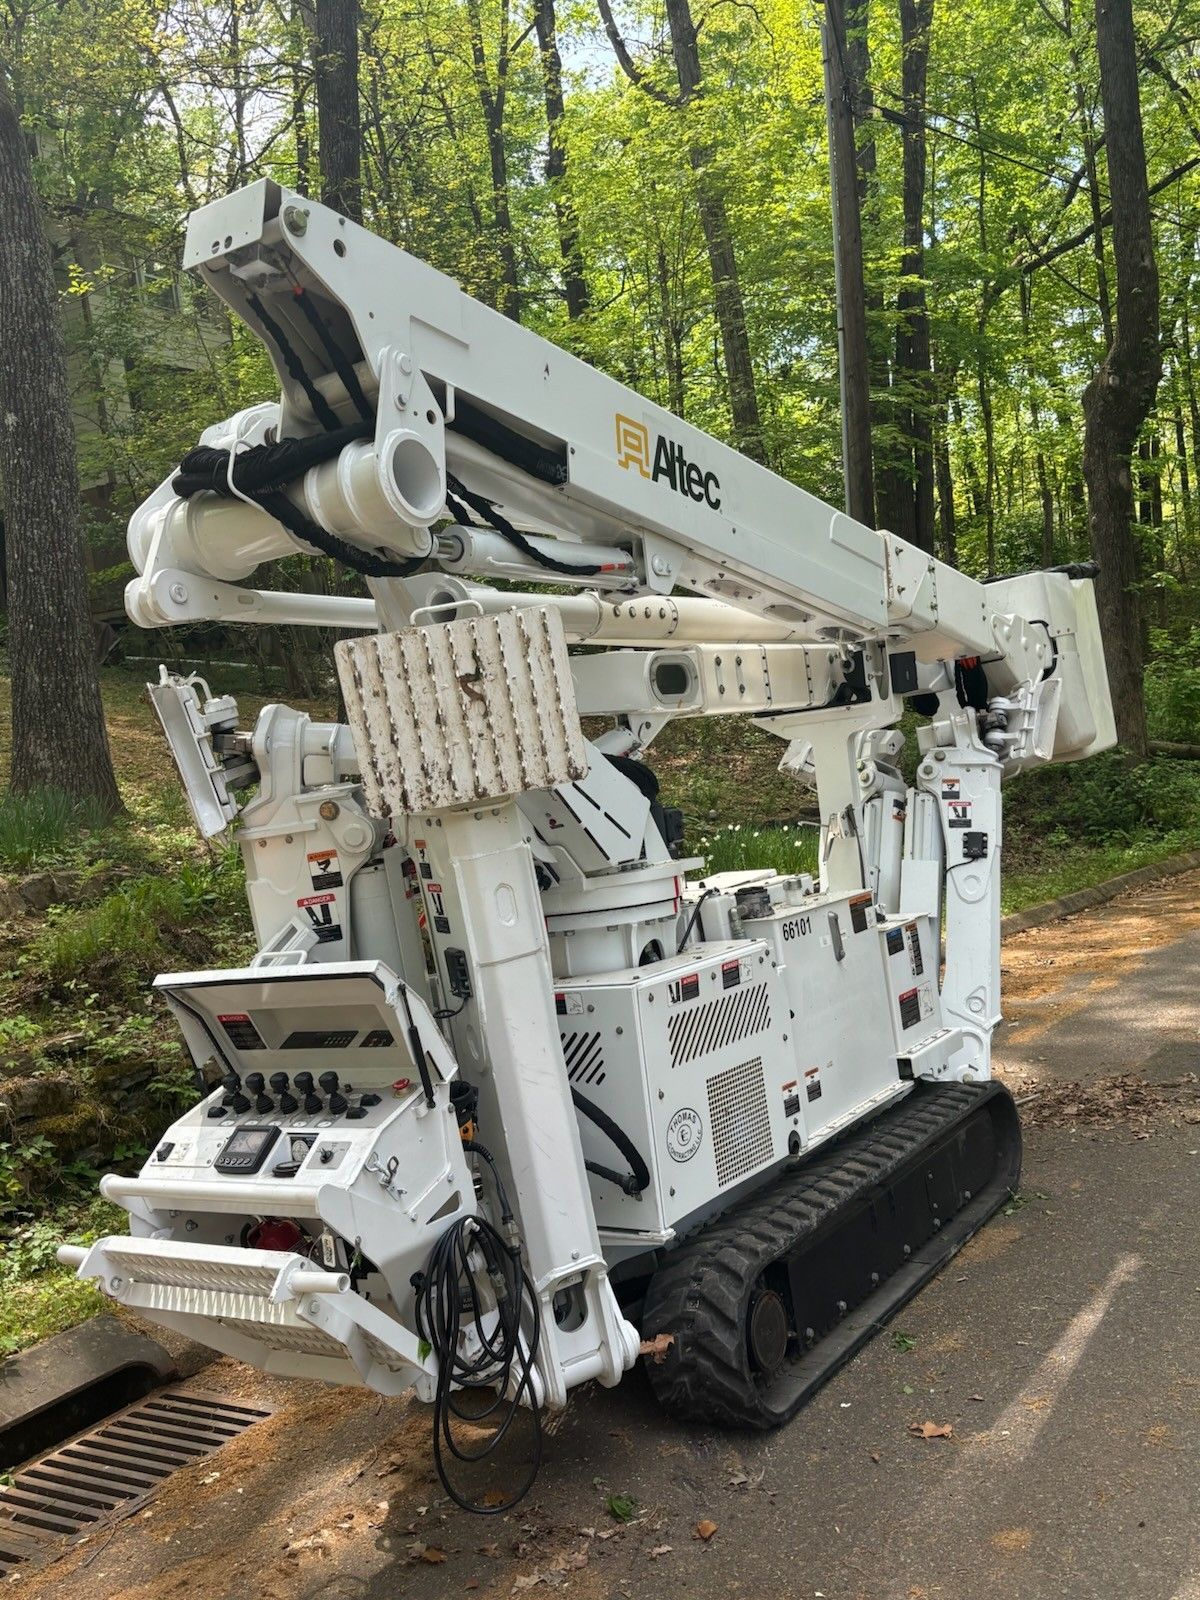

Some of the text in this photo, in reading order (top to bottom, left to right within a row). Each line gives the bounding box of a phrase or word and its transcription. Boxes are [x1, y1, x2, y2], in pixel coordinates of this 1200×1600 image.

[652, 434, 721, 511] Altec
[782, 916, 812, 941] 66101
[670, 1111, 697, 1133] THOMAS
